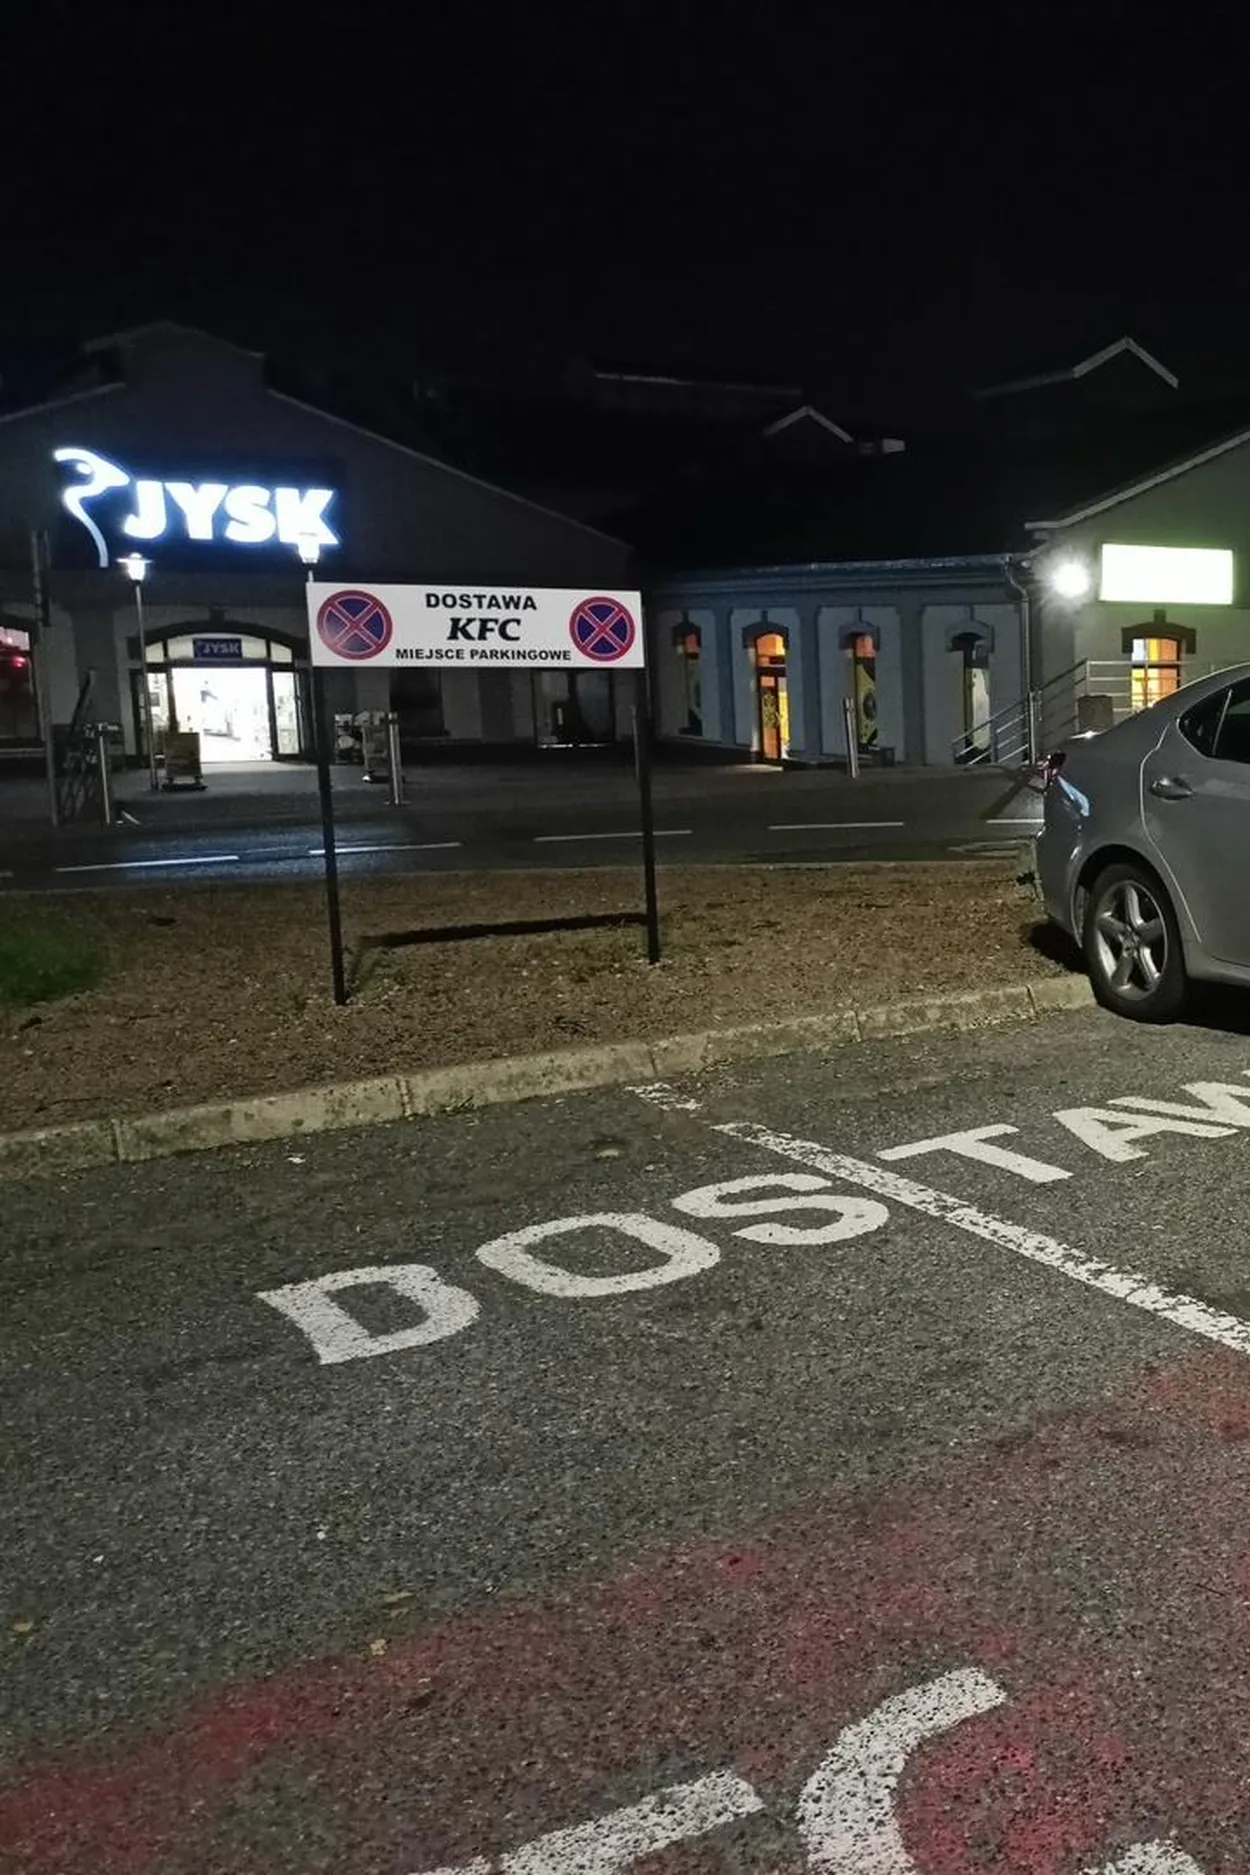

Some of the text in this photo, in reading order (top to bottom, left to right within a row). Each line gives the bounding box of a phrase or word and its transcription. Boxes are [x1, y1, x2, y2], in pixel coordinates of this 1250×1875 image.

[123, 480, 339, 546] JYSK
[425, 593, 537, 611] DOSTAWA
[447, 617, 520, 641] KFC
[395, 648, 571, 661] MIEJSCE PARKINGOWE
